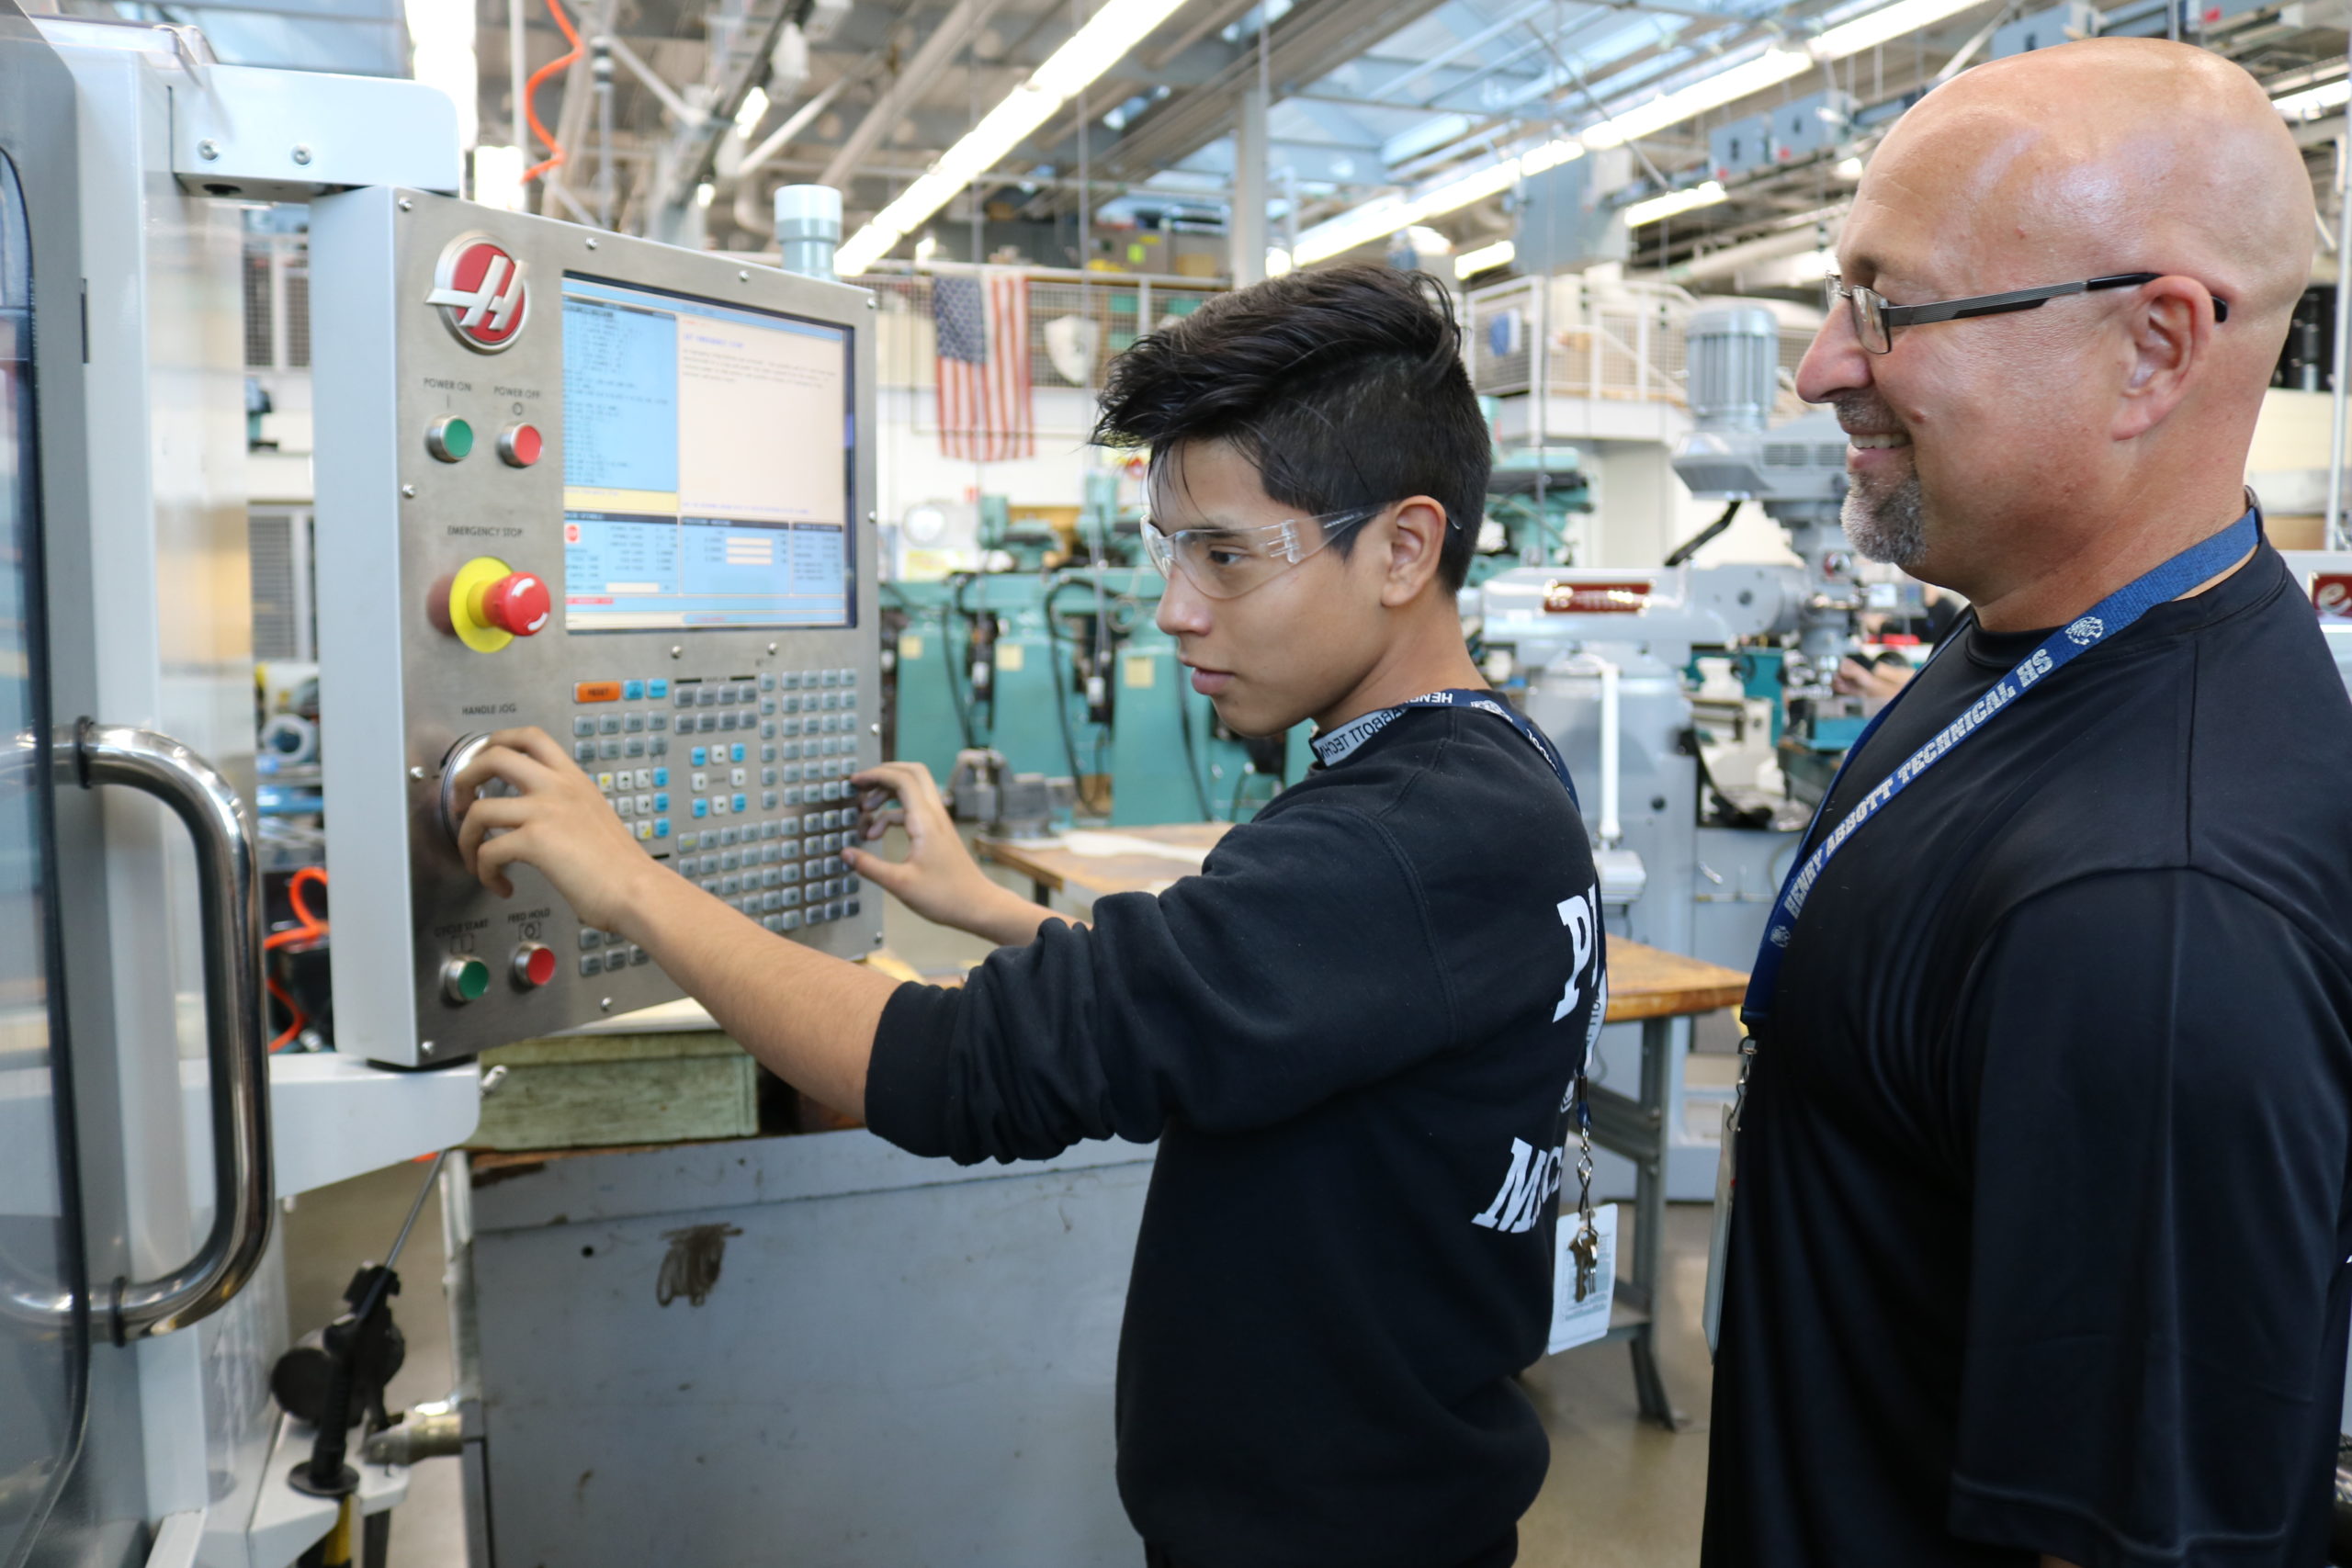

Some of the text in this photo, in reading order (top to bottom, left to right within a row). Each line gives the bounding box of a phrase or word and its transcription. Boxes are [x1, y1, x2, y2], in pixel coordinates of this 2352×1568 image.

[424, 378, 472, 392] POWER ON
[493, 386, 540, 400] POWER OFF
[447, 525, 523, 537] EMERGENCY STOP
[1404, 692, 1453, 705] HEN
[462, 702, 517, 716] HANDLE JOG
[1783, 649, 2053, 919] HENRY ABBOTT TECHNICAL HS
[508, 908, 551, 923] FEED HOLD
